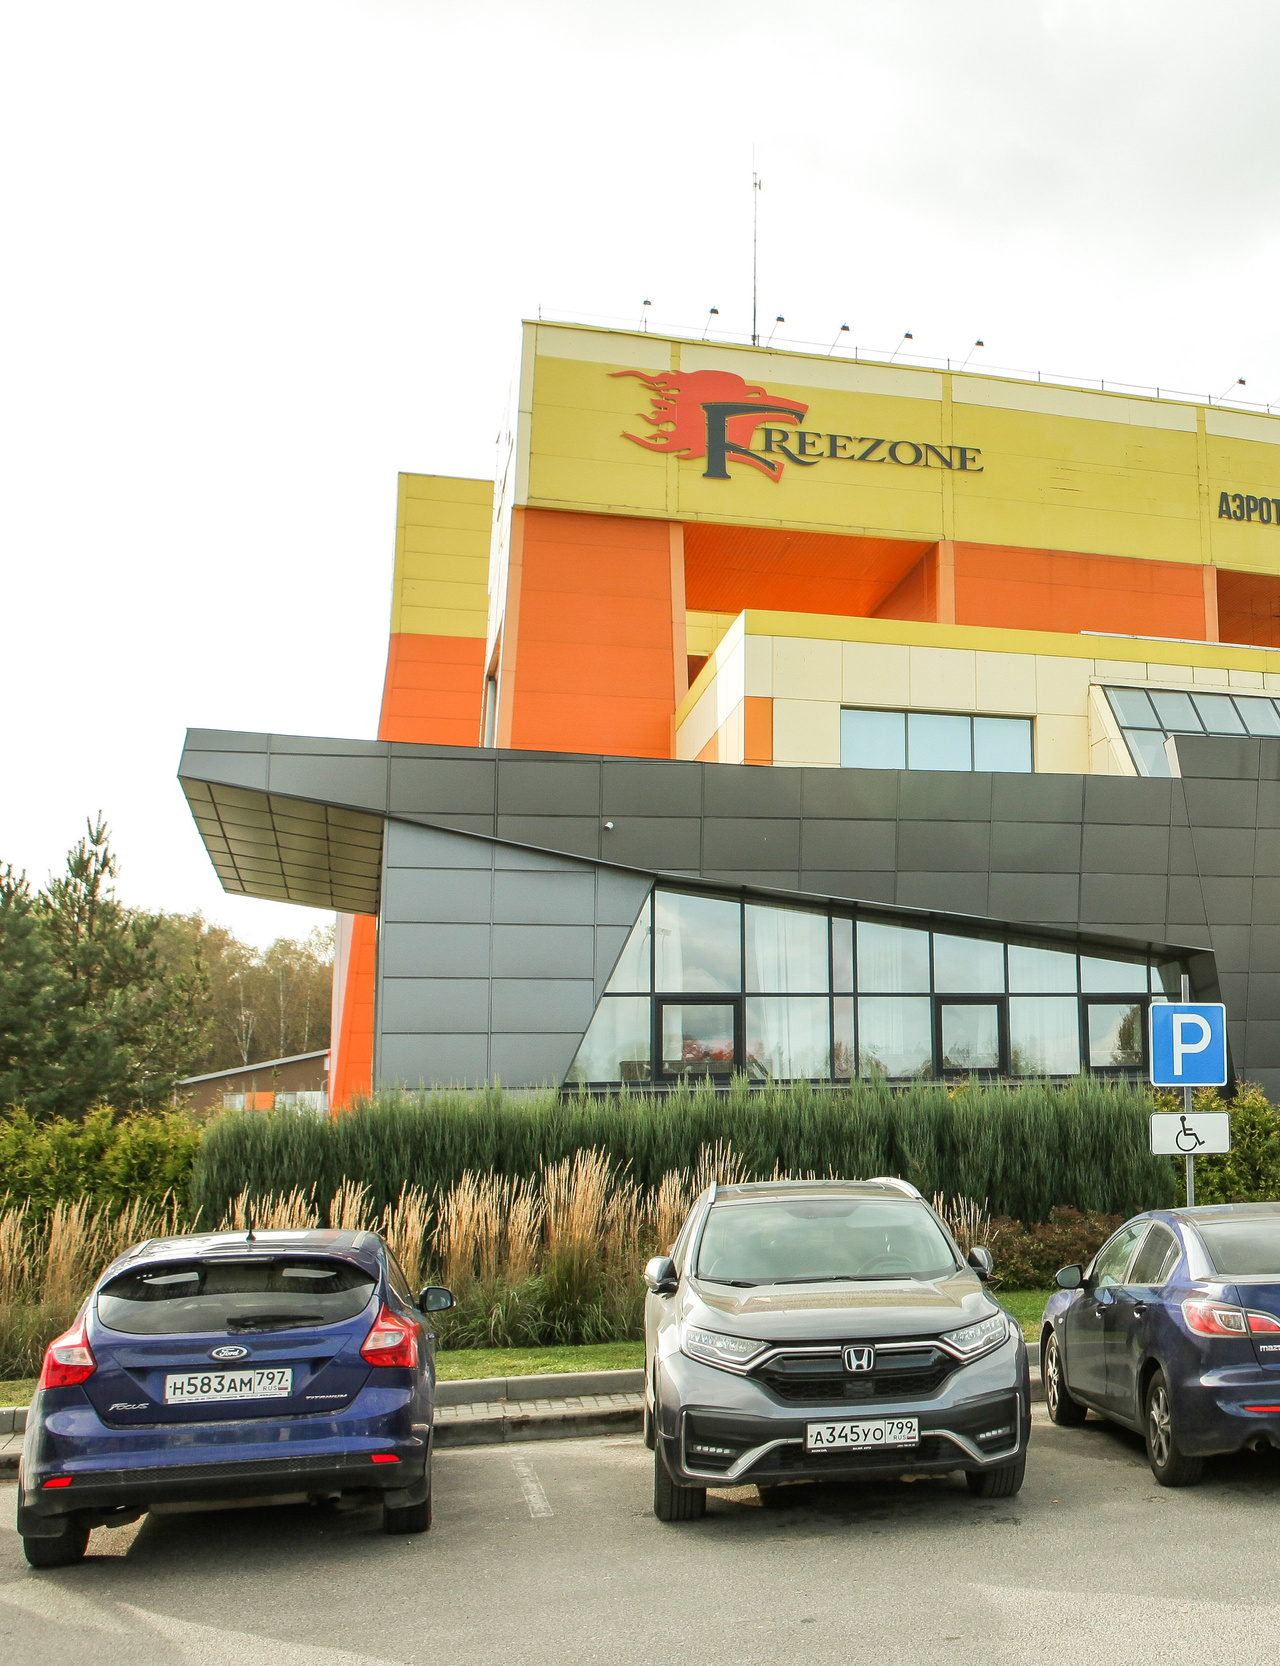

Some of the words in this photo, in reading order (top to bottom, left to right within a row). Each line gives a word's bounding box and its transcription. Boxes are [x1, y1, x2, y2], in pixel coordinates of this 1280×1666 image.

[701, 402, 985, 481] FREEZONE
[1172, 1013, 1212, 1076] P
[218, 1347, 241, 1357] Ford
[172, 1374, 253, 1396] Н583АМ
[255, 1370, 287, 1386] 797
[813, 1424, 884, 1445] А345УО
[886, 1420, 914, 1436] 799
